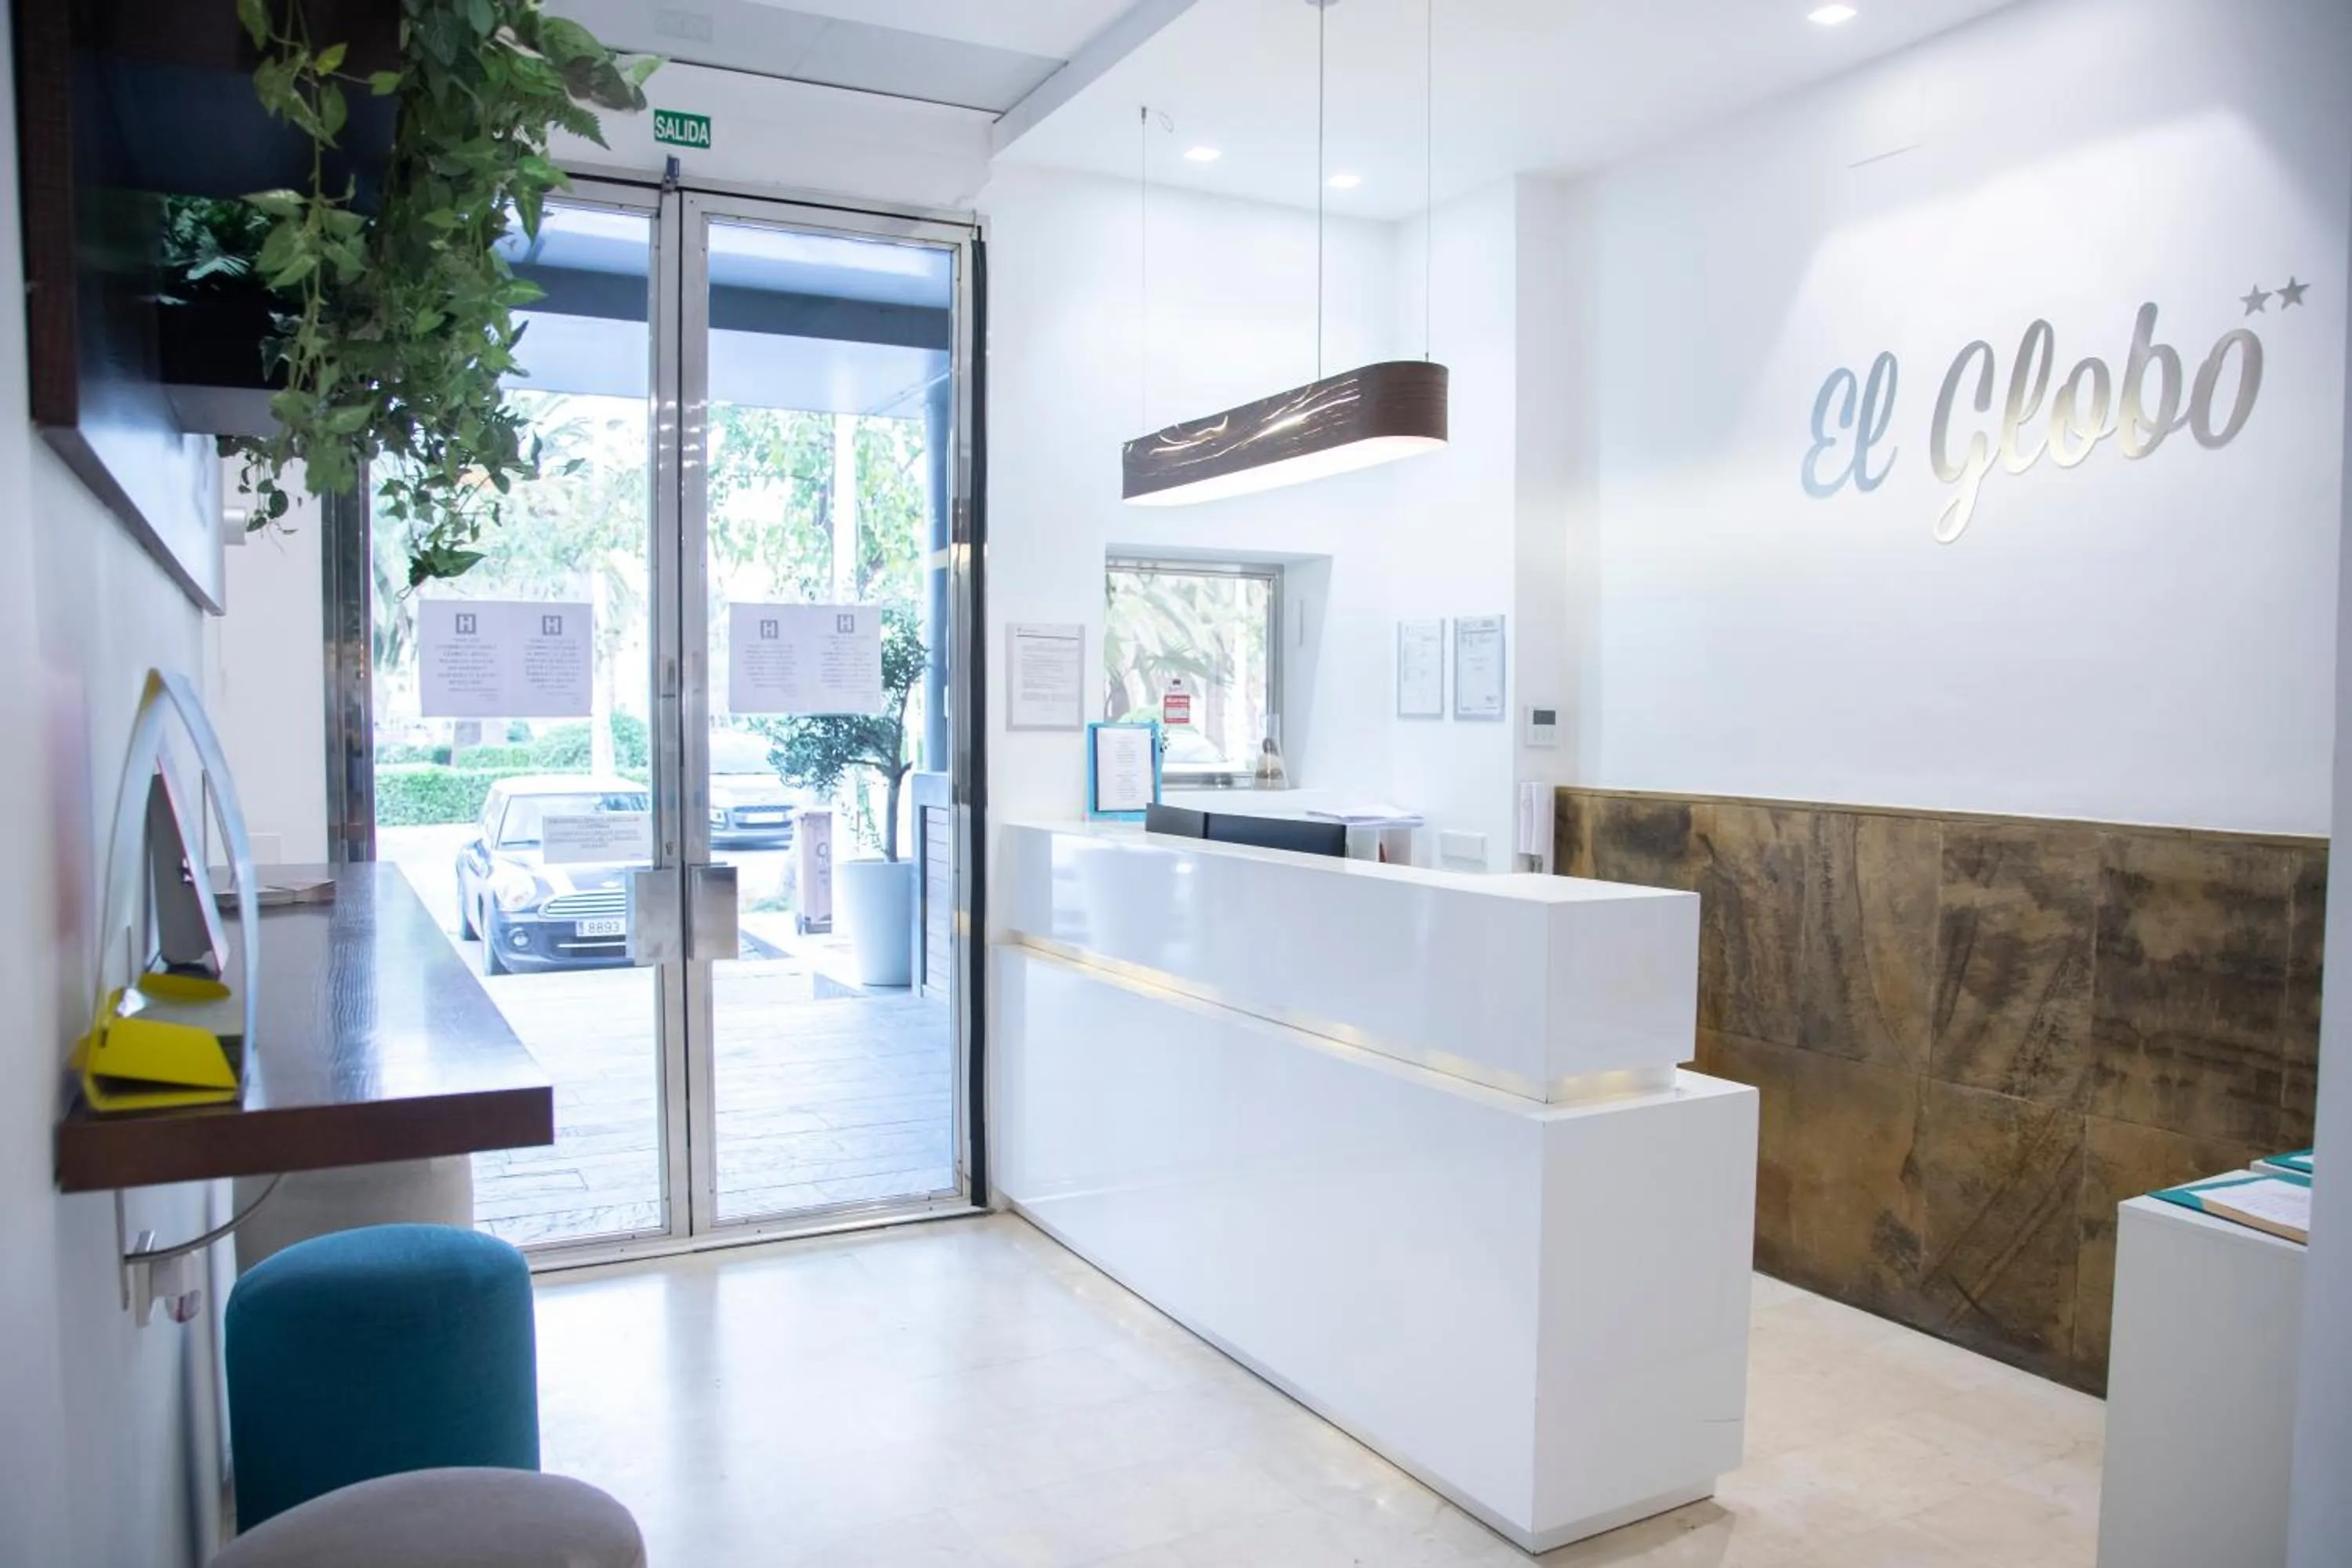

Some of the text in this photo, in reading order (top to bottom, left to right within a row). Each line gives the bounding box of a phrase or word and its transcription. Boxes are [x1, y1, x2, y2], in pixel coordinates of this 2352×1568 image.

[655, 115, 709, 144] SALIDA
[1801, 301, 2264, 544] El Globo
[587, 920, 621, 934] 8893
